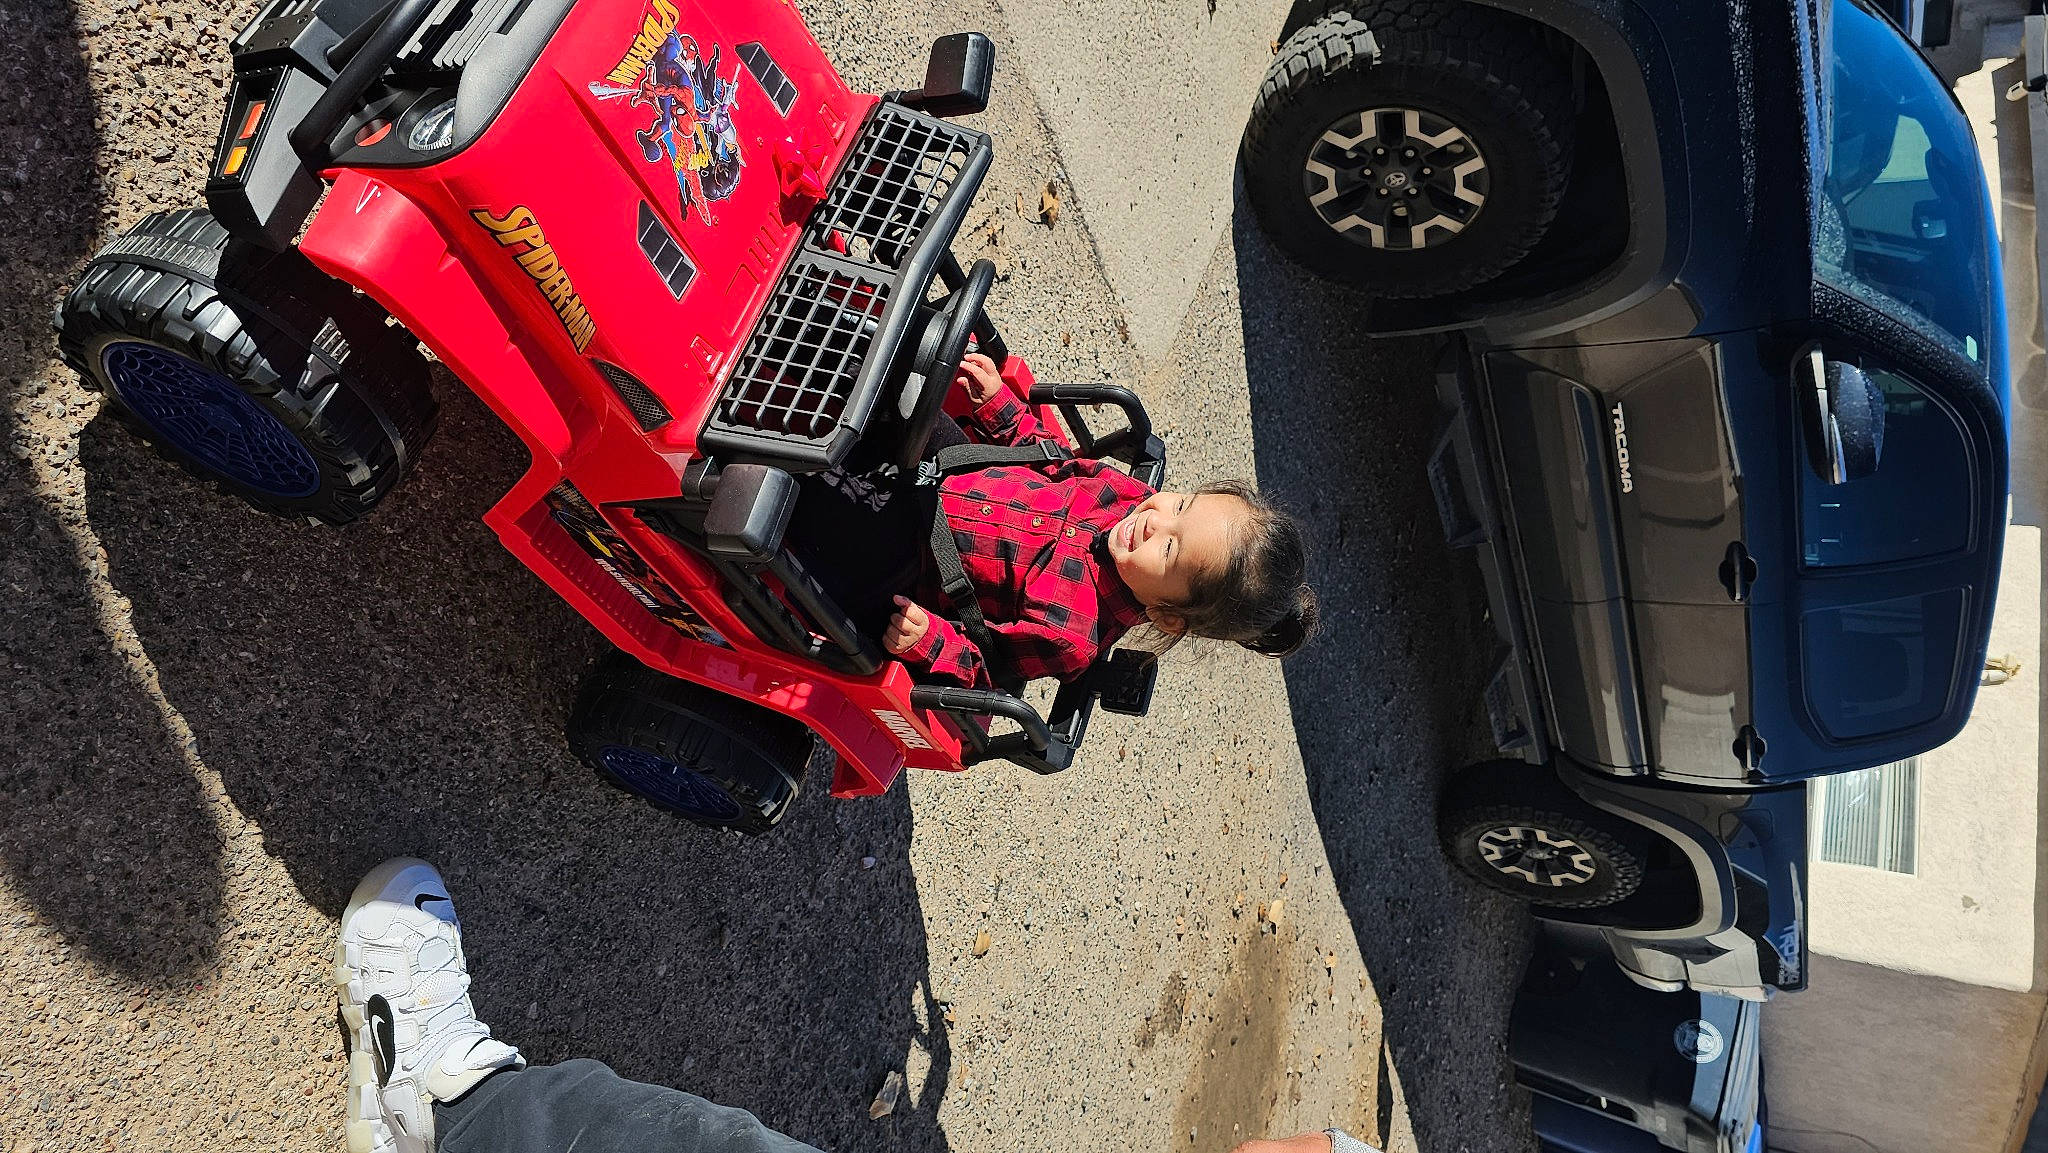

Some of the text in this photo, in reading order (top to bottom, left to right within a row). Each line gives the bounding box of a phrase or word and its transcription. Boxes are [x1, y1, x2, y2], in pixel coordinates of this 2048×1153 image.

[605, 0, 680, 86] SPIDER-MAN
[470, 205, 597, 355] SPIDER-MAN
[1612, 402, 1633, 493] TACOMA
[870, 709, 933, 750] MARVEL
